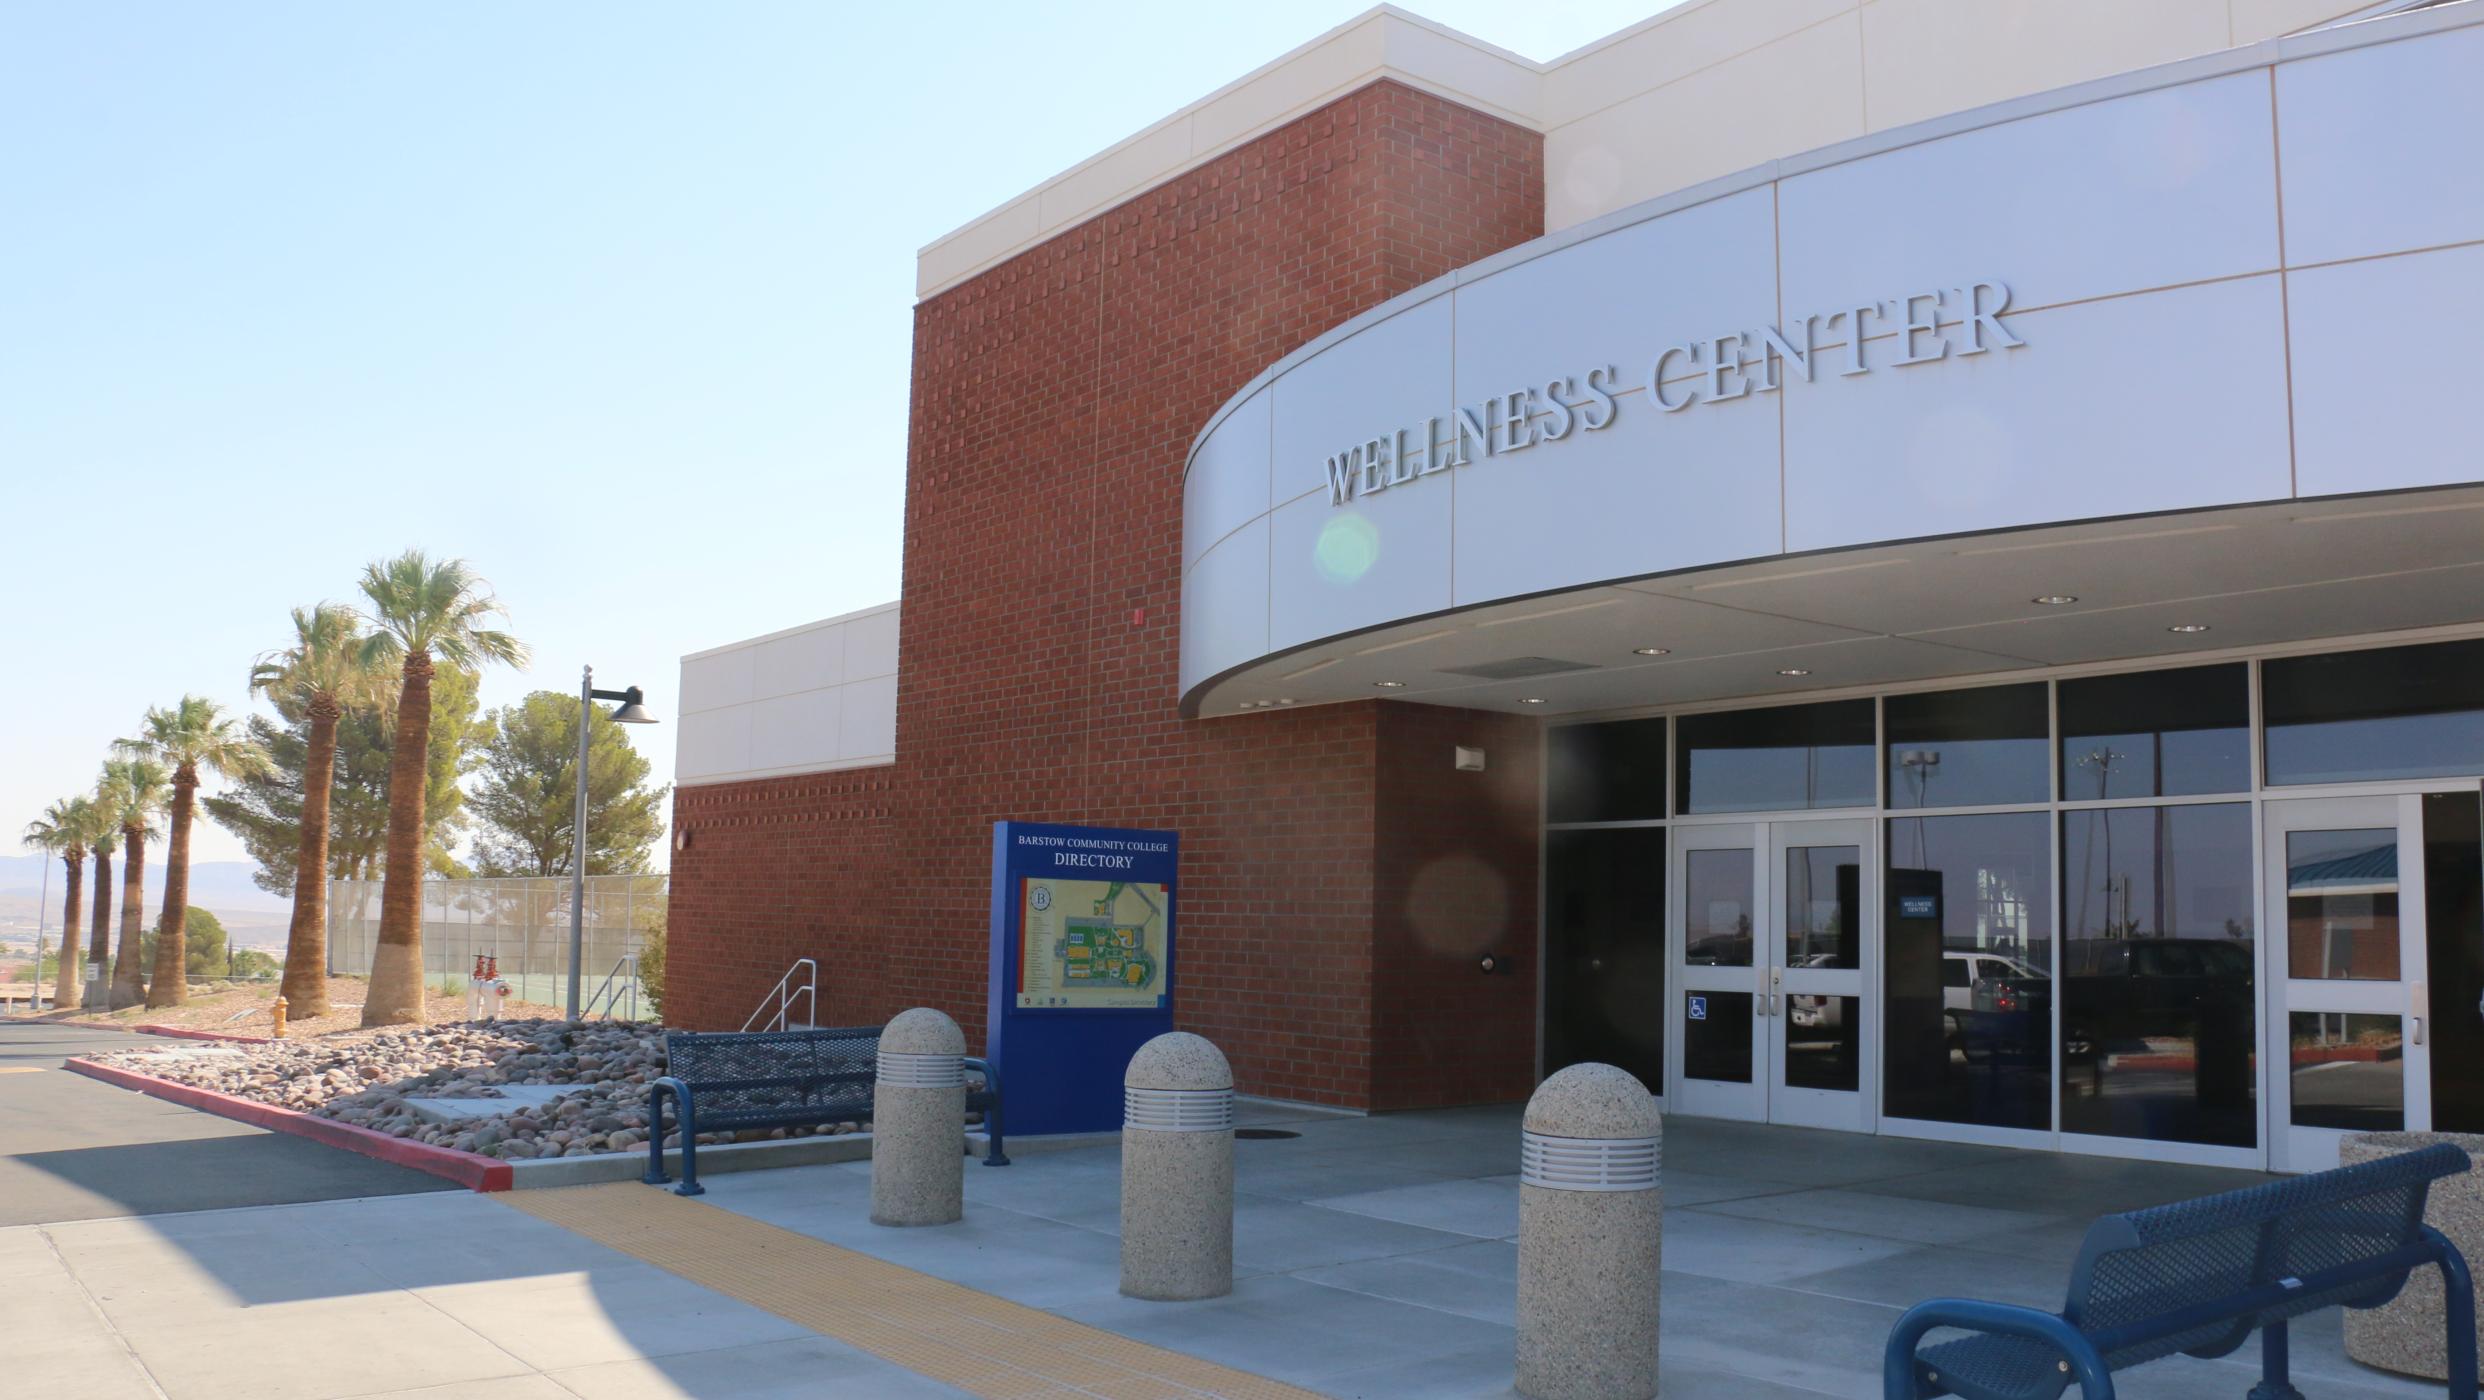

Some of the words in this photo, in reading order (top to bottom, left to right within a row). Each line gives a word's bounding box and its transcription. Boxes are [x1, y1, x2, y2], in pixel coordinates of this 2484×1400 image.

[1322, 364, 1618, 506] WELLNESS
[1645, 279, 2030, 412] CENTER
[1018, 835, 1066, 847] BARSTOW
[1067, 838, 1126, 851] COMMUNITY
[1127, 842, 1169, 852] COLLEGE
[1054, 852, 1134, 869] DIRECTORY
